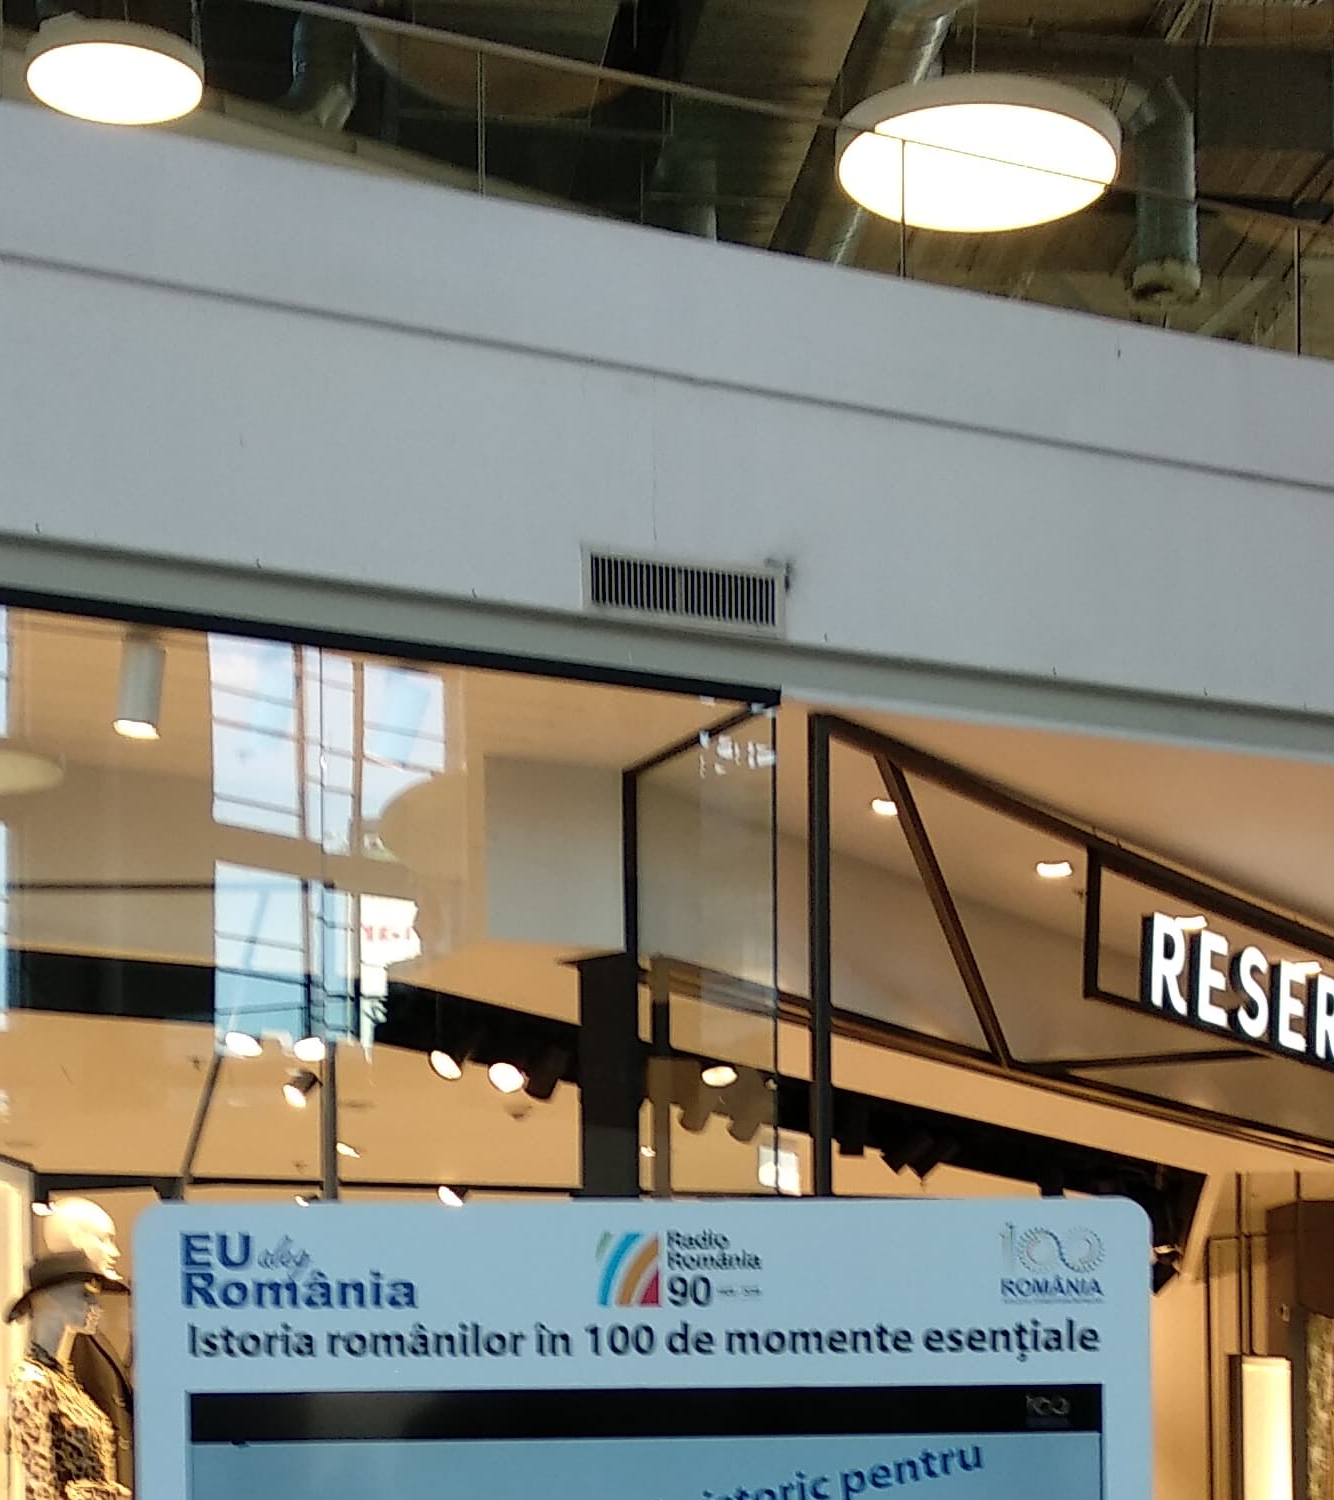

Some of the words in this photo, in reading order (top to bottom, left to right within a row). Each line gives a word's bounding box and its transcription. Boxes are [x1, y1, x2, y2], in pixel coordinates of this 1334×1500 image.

[180, 1233, 252, 1270] EU
[667, 1229, 730, 1250] Radio
[667, 1250, 762, 1271] România
[181, 1272, 418, 1308] România
[667, 1276, 711, 1307] 90
[187, 1322, 316, 1357] Istoria
[327, 1322, 525, 1357] românilor
[536, 1322, 572, 1356] în
[586, 1325, 655, 1355] 100
[667, 1322, 714, 1355] de
[726, 1323, 914, 1355] momente
